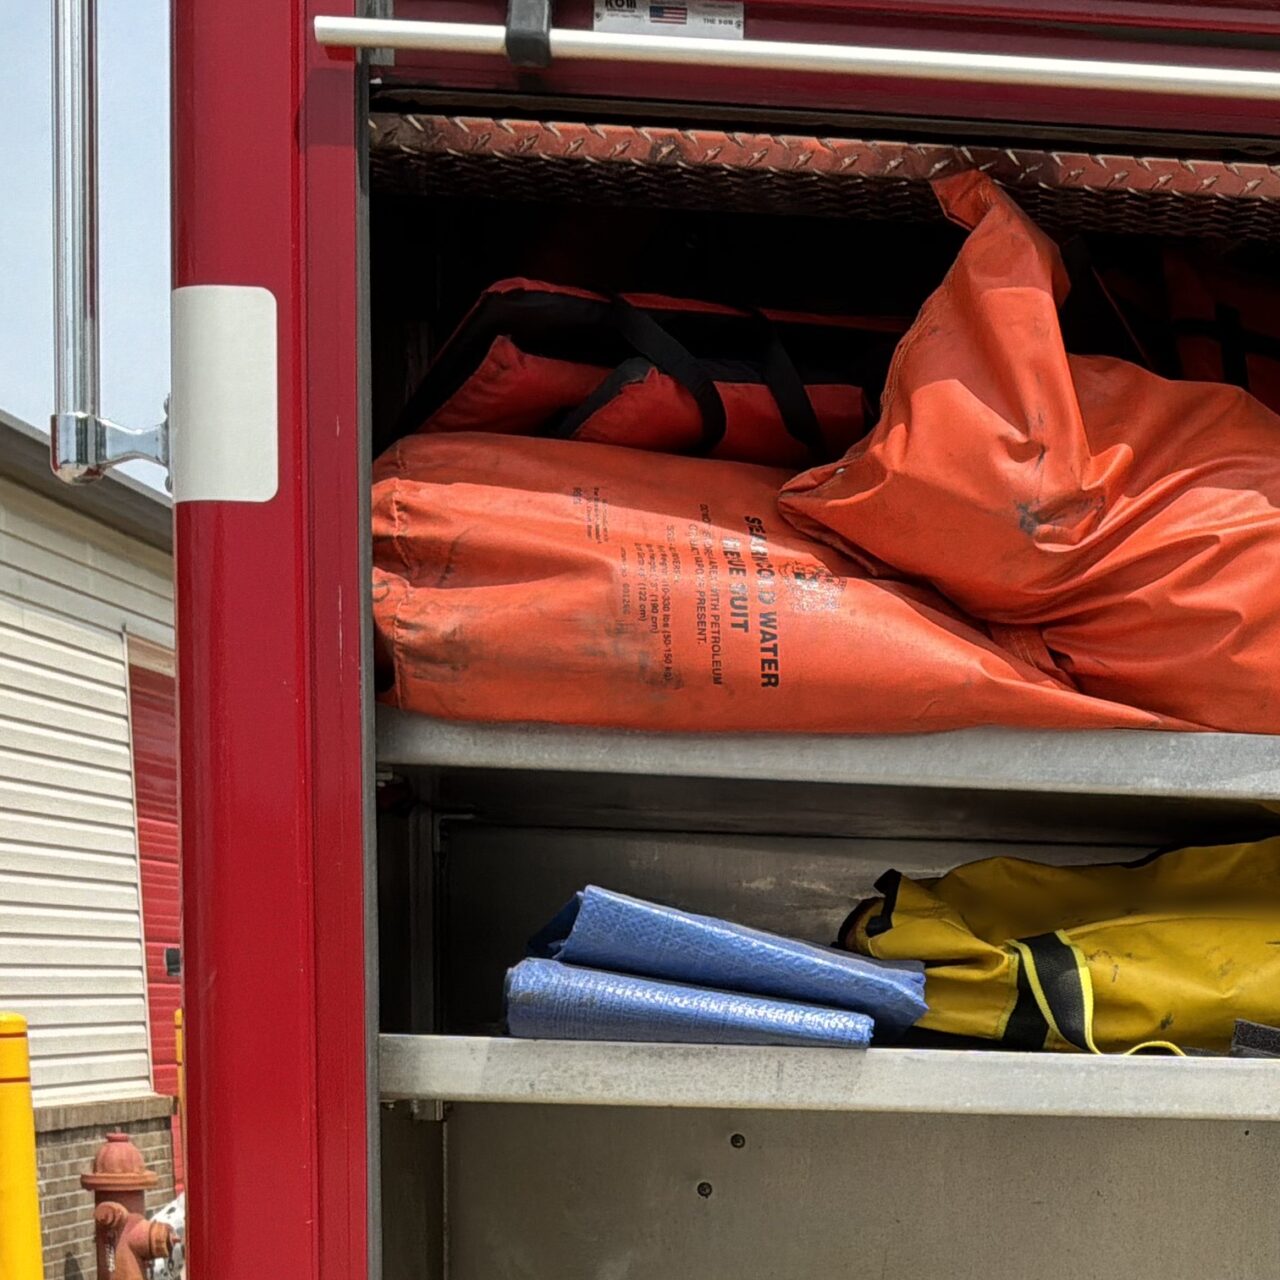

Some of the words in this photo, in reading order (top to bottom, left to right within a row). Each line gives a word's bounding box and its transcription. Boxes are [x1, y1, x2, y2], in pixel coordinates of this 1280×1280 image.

[695, 590, 708, 645] PRESENT.
[710, 615, 722, 685] PETROLEUM
[760, 612, 779, 688] WATER
